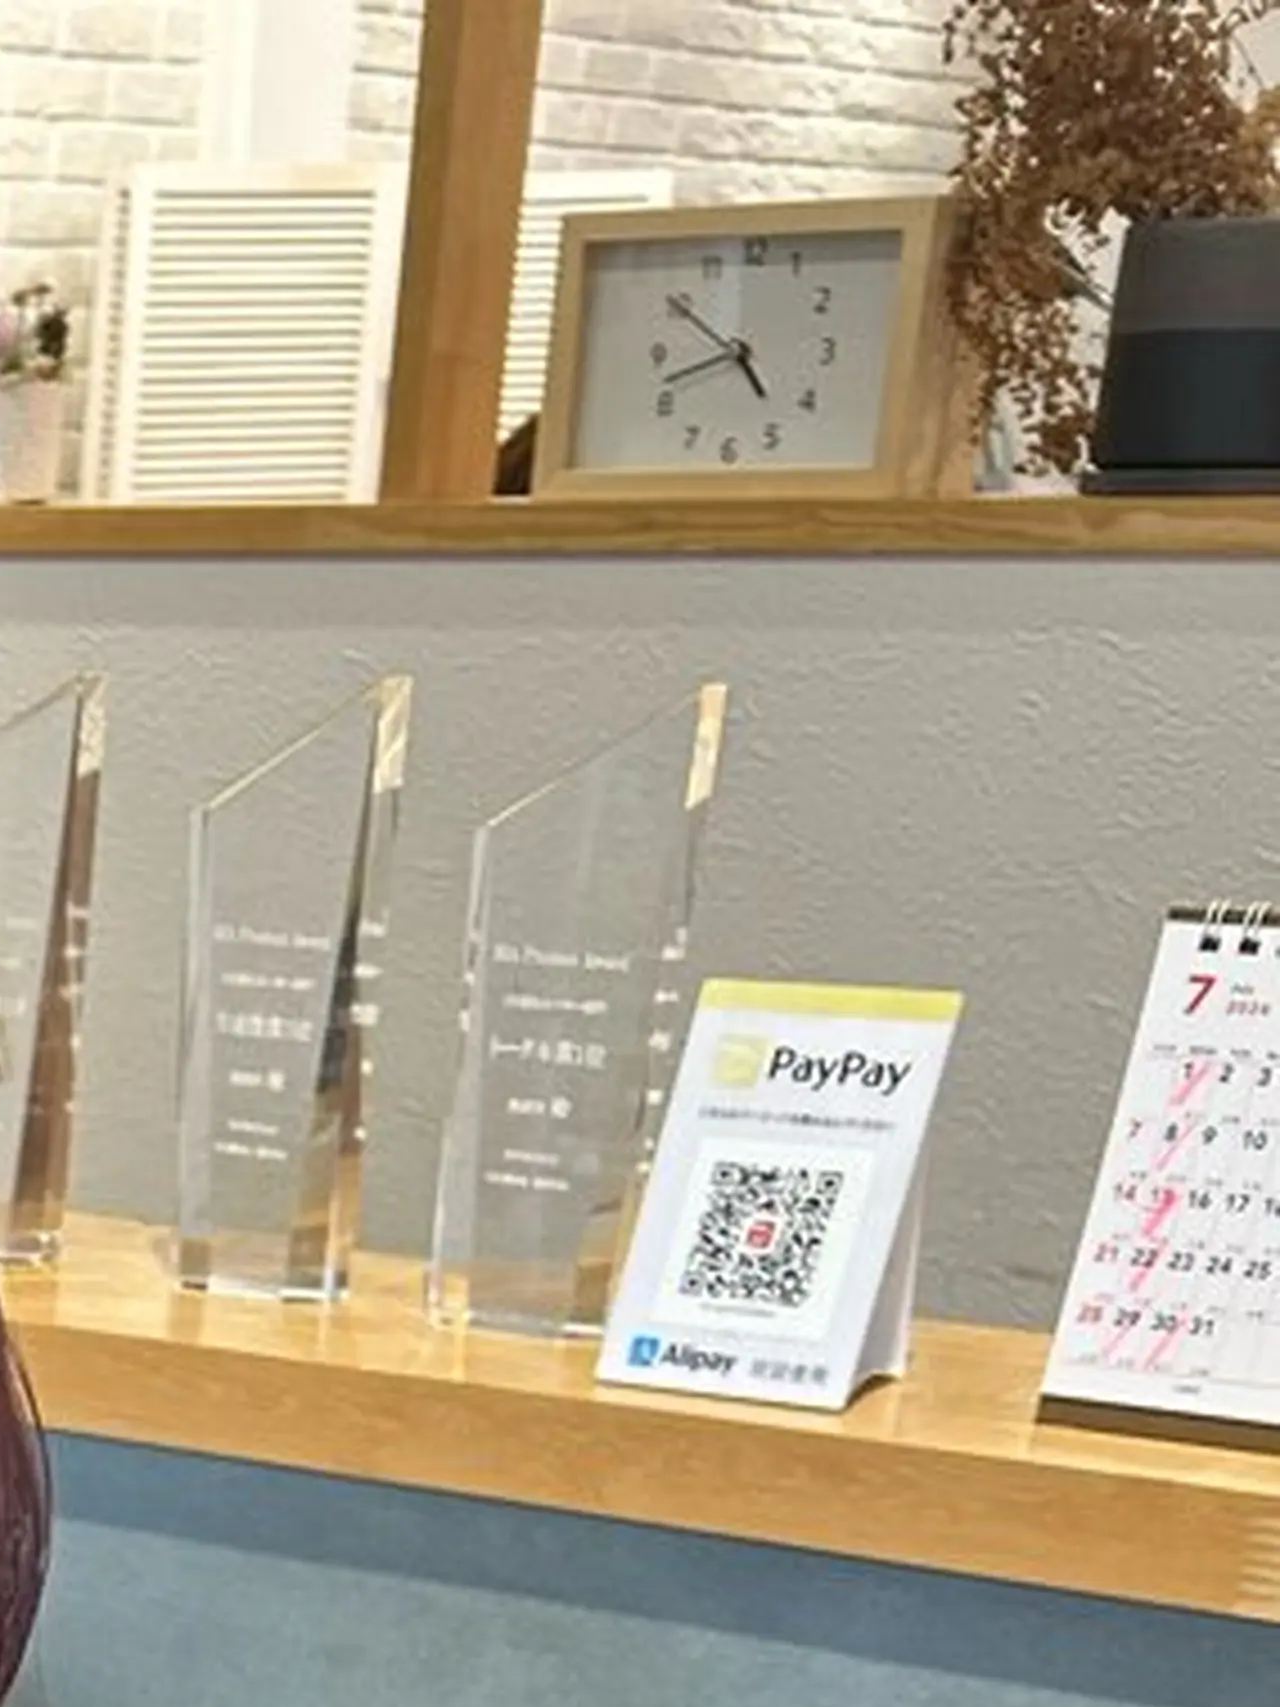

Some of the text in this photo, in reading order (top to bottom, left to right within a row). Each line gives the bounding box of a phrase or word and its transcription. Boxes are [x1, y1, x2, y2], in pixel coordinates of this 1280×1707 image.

[744, 235, 767, 267] 12
[790, 251, 801, 278] 1
[813, 286, 831, 315] 2
[820, 336, 836, 367] 3
[657, 390, 675, 418] 8
[797, 388, 816, 414] 4
[684, 424, 701, 450] 7
[719, 435, 739, 465] 6
[763, 421, 782, 451] 5
[1183, 973, 1216, 1014] 7
[768, 1045, 912, 1096] PayPay
[1218, 1063, 1234, 1084] 2
[1257, 1066, 1272, 1088] 3
[1127, 1117, 1268, 1151] 7 8 9 10
[1189, 1189, 1212, 1209] 16
[1226, 1193, 1251, 1213] 17
[1093, 1243, 1272, 1281] 21 22 23 24 25
[1113, 1308, 1142, 1328] 29
[1149, 1312, 1179, 1333] 30
[1188, 1315, 1215, 1336] 31
[660, 1342, 738, 1376] Alipay
